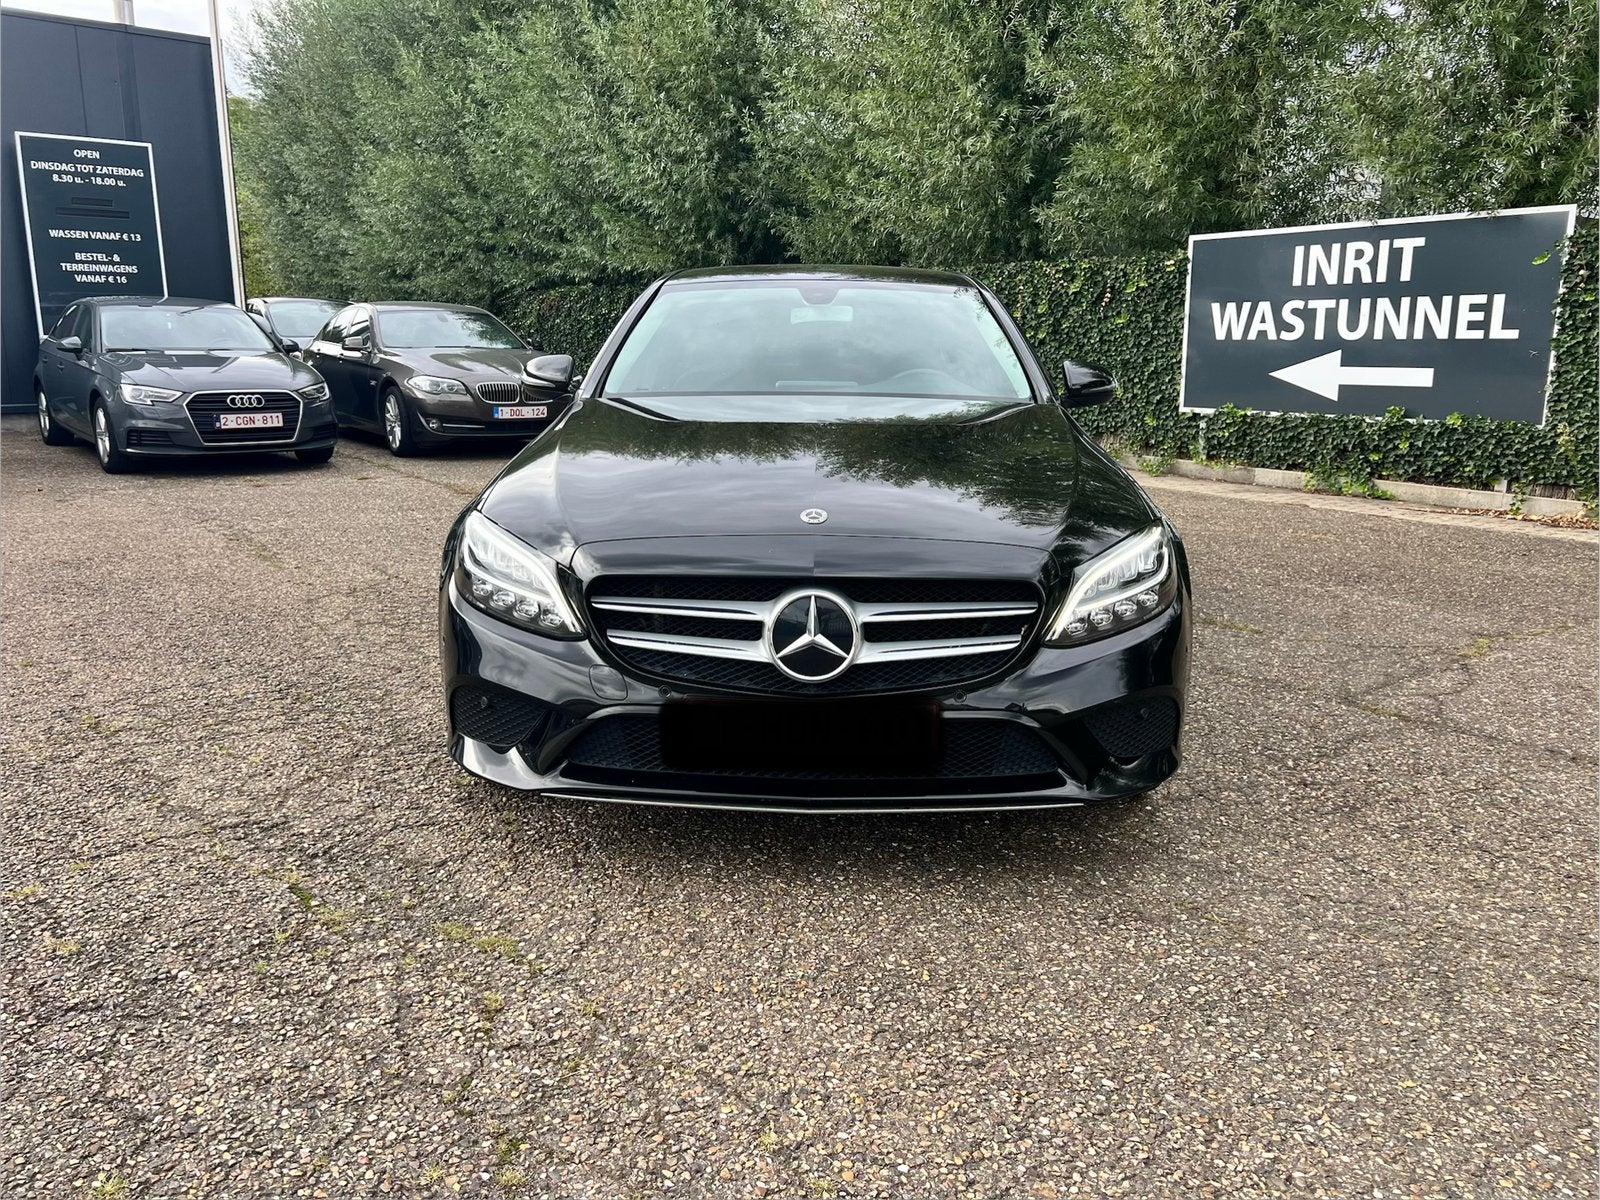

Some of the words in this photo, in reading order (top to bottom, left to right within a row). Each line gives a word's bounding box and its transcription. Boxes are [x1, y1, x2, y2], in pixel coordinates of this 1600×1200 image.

[73, 149, 100, 159] OPEN
[30, 160, 75, 172] DINSDAG
[76, 164, 95, 173] TOT
[96, 165, 144, 177] ZATERDAG
[52, 174, 73, 183] 8.30
[74, 176, 84, 184] u.
[91, 176, 116, 186] 18.00
[117, 179, 126, 187] u.
[48, 229, 88, 239] WASSEN
[89, 231, 121, 241] VANAF
[130, 233, 141, 242] 13
[74, 252, 112, 262] BESTEL-
[112, 253, 121, 262] &
[1291, 236, 1426, 287] INRIT
[60, 262, 138, 274] TERREINWAGENS
[74, 274, 107, 283] VANAF
[116, 275, 127, 284] 16
[1210, 293, 1520, 342] WASTUNNEL
